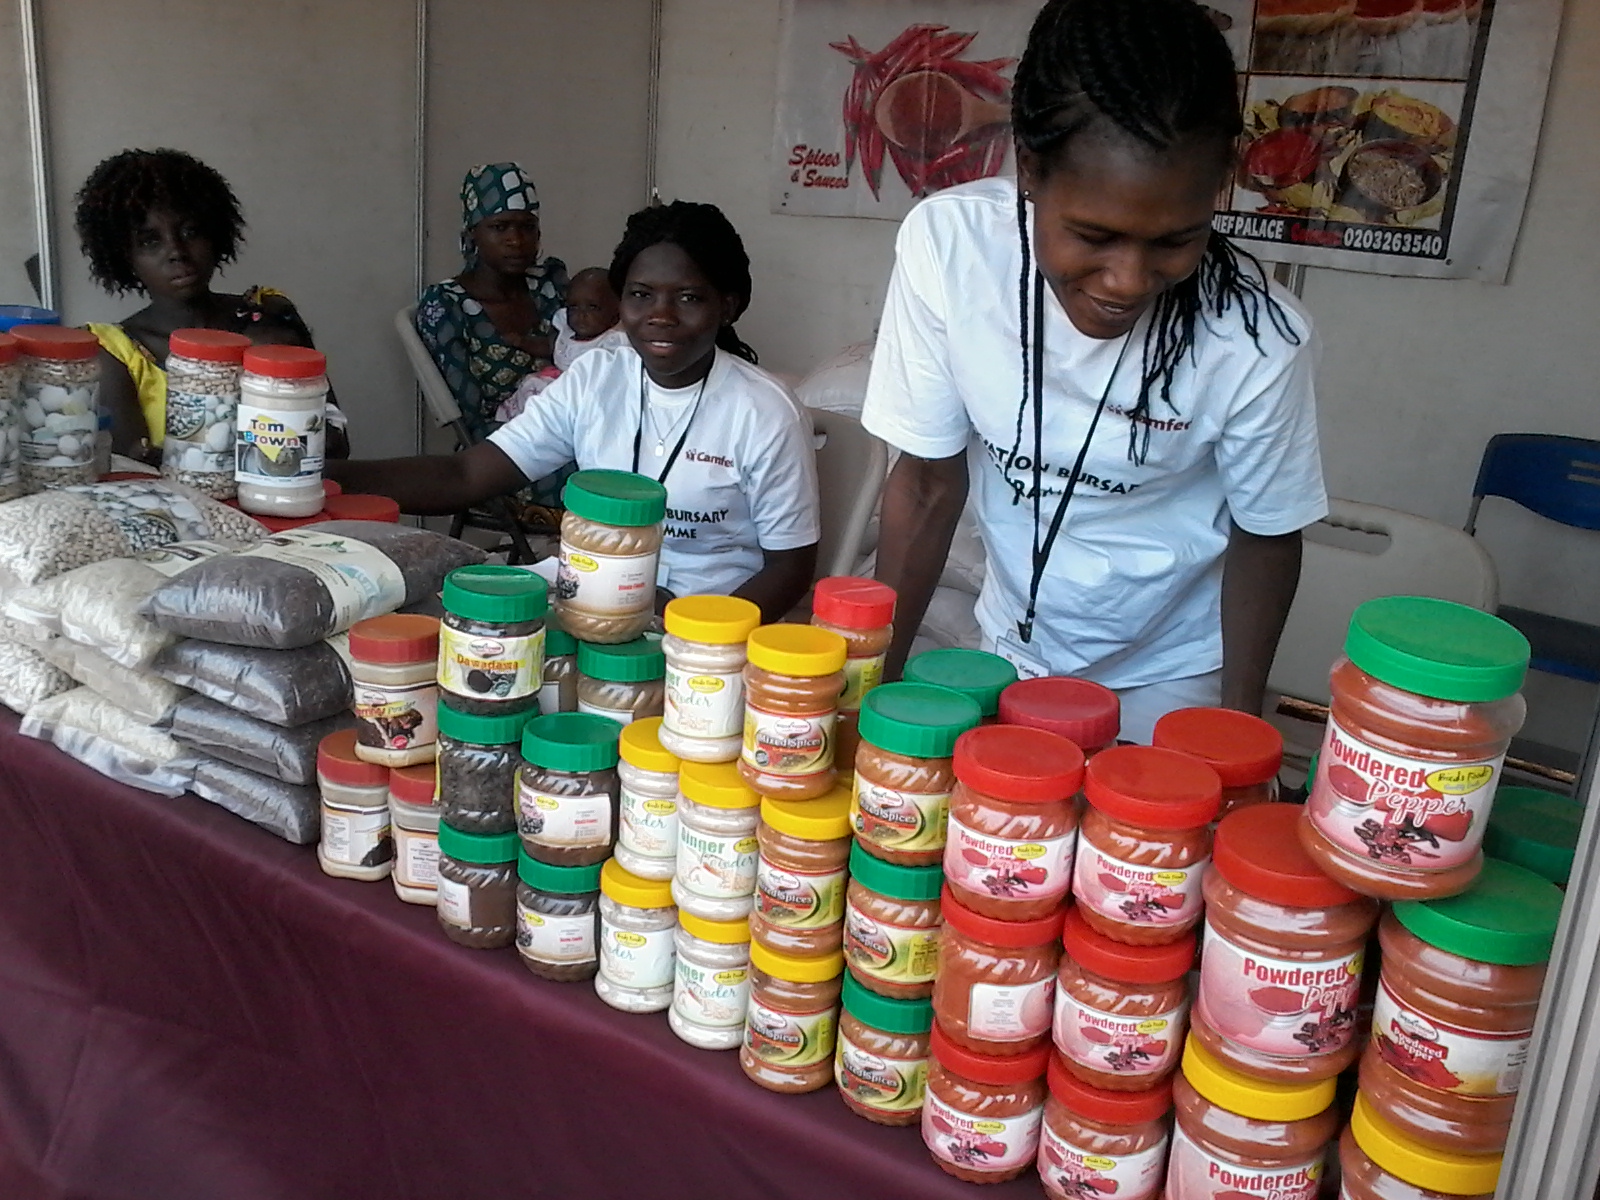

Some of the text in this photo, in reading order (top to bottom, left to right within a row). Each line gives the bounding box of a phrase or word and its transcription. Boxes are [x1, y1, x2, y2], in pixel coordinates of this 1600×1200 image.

[789, 145, 840, 170] Spices
[790, 169, 849, 188] & Sauces
[1234, 216, 1284, 239] PALACE
[1343, 228, 1442, 256] 0203263540
[251, 419, 284, 432] Tom
[244, 431, 299, 448] Brown
[666, 508, 729, 524] BURSARY
[1329, 729, 1425, 788] Powdered
[1367, 777, 1468, 826] Pepper
[960, 830, 1013, 856] Powdered
[1097, 855, 1153, 881] Powdered
[1243, 957, 1347, 986] Powdered
[1079, 1009, 1136, 1032] Powdered
[1394, 1026, 1443, 1058] Powdered
[1398, 1038, 1433, 1062] Pepper
[931, 1097, 974, 1129] Powdered
[1209, 1161, 1306, 1191] Powdered
